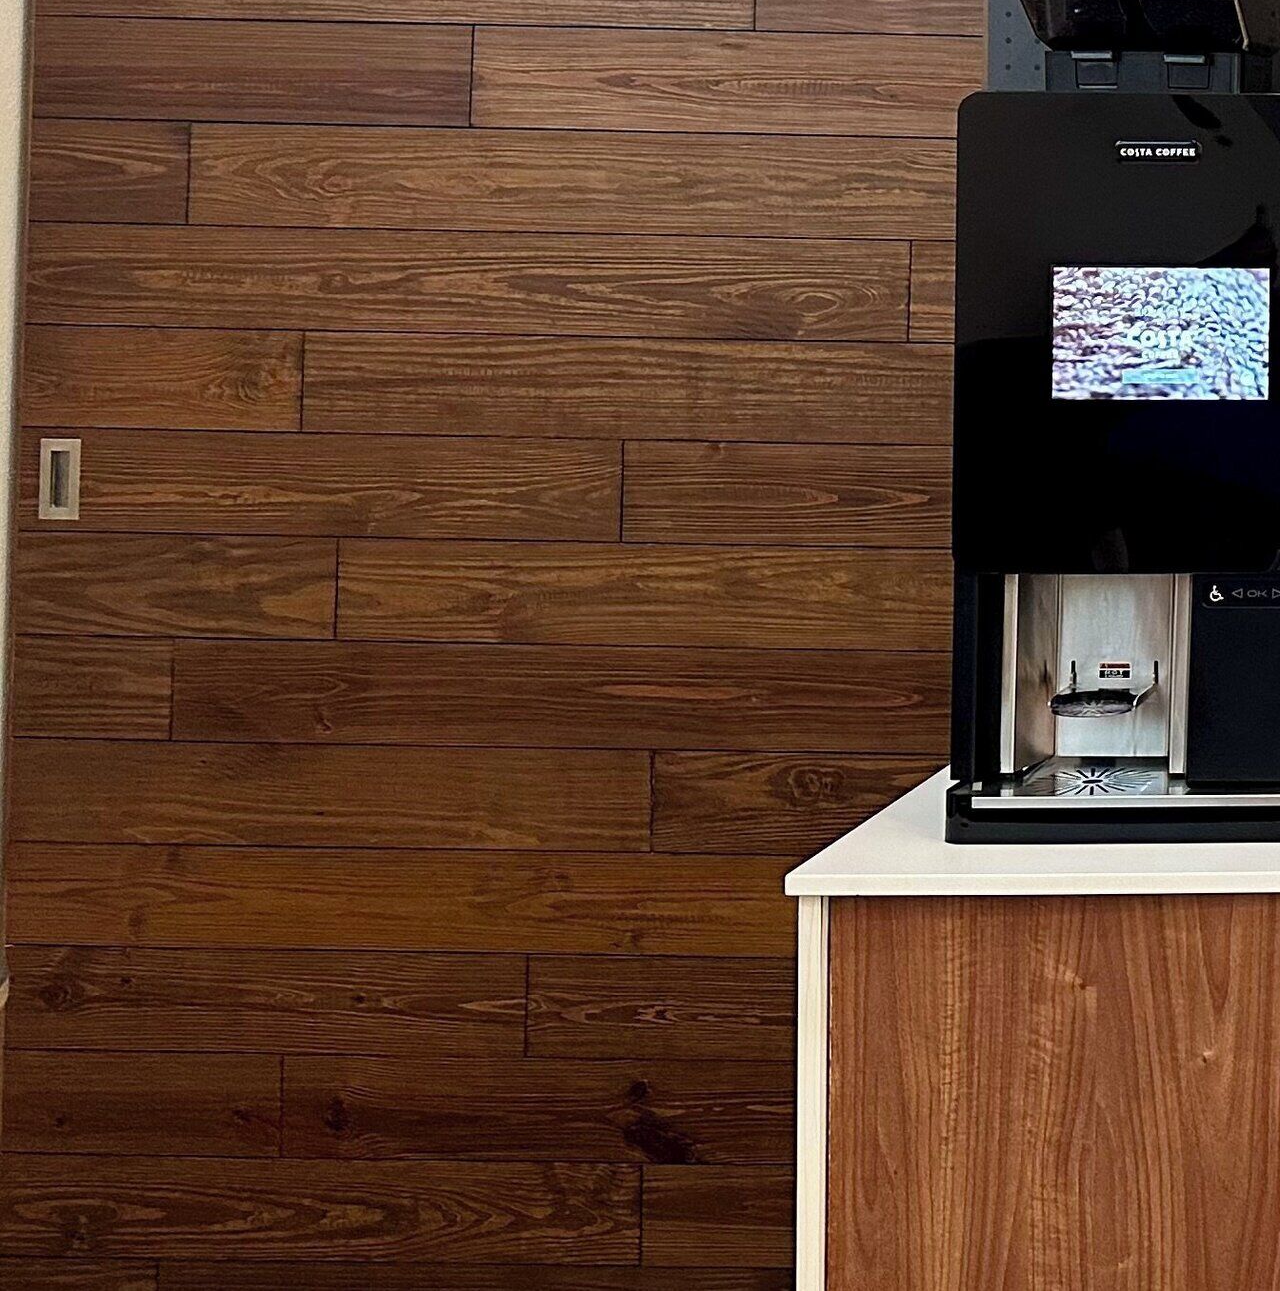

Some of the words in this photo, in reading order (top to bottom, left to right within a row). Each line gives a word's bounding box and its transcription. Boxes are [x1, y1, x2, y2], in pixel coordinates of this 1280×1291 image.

[1119, 148, 1153, 157] COSTA
[1155, 147, 1196, 157] COFFEE
[1246, 589, 1268, 598] OK
